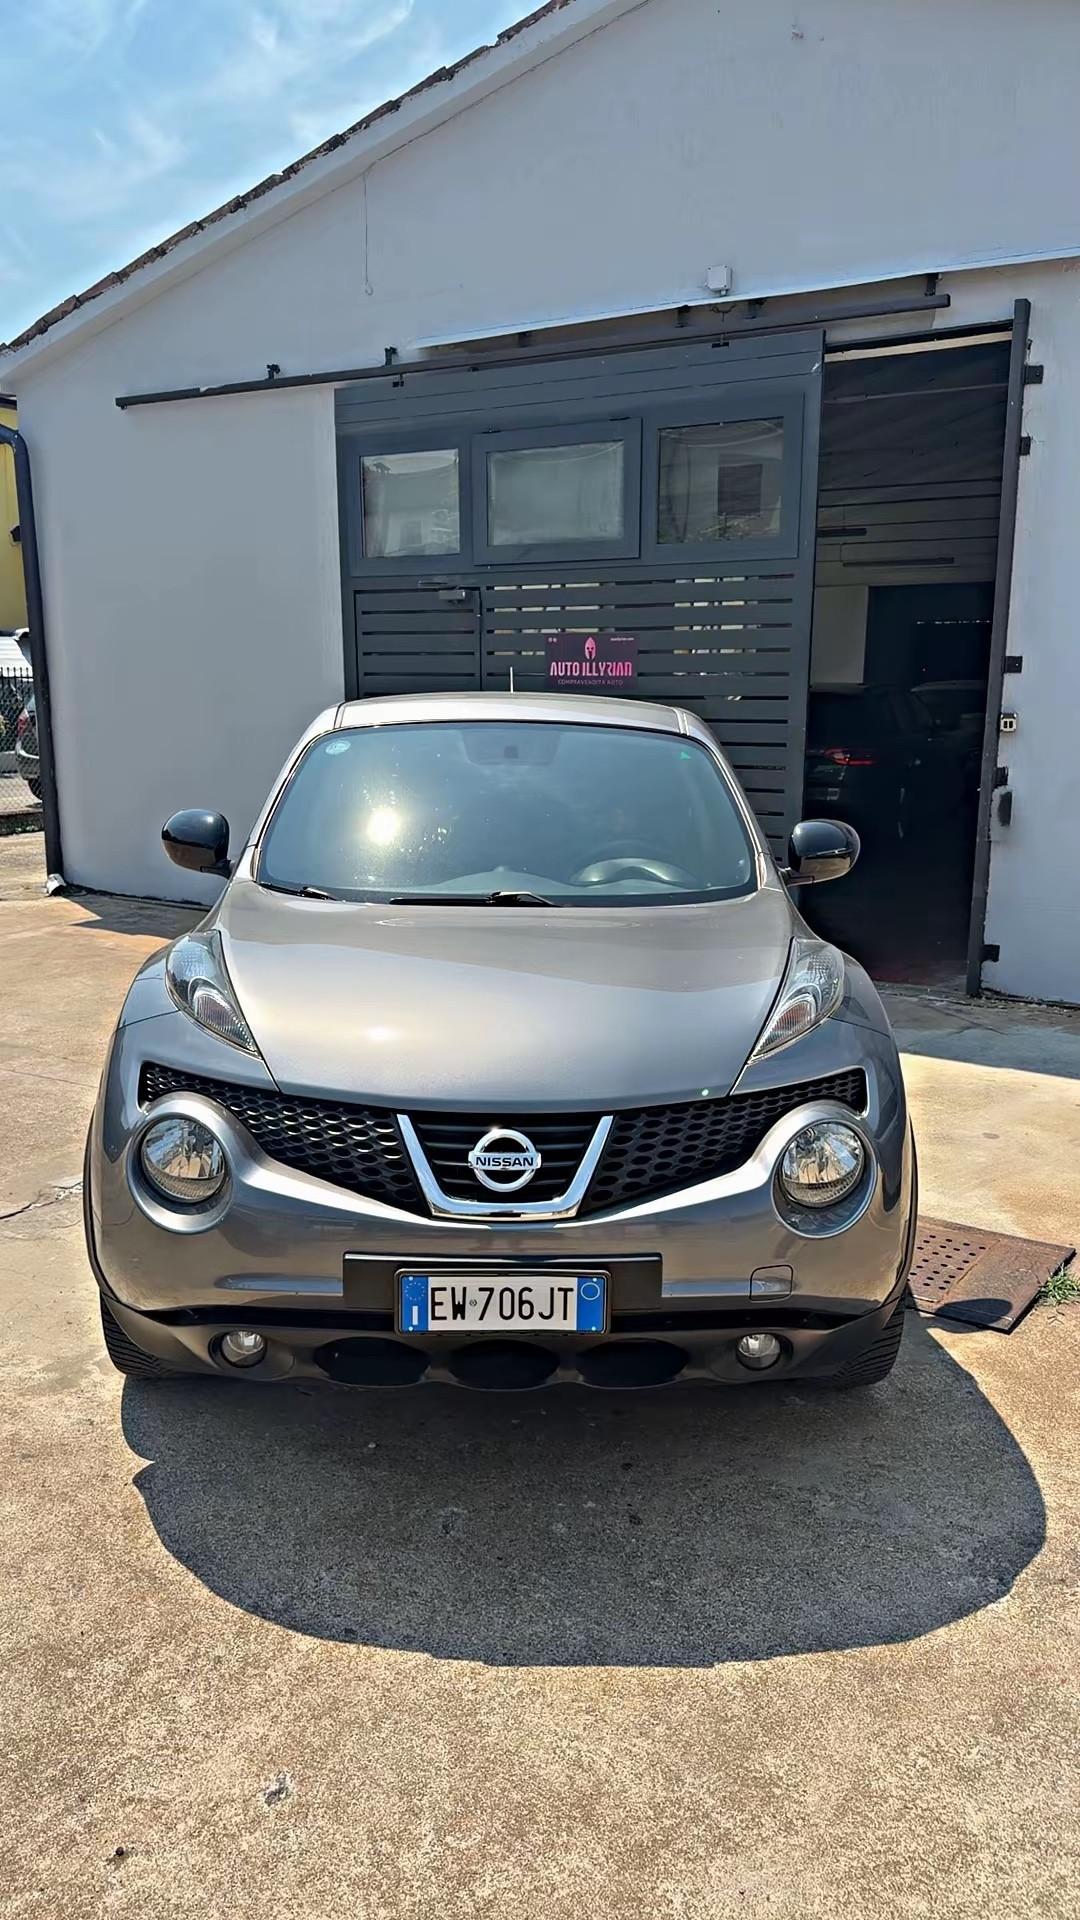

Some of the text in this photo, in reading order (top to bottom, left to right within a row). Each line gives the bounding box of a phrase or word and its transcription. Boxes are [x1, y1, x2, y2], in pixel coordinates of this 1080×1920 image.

[549, 661, 632, 676] AUTO ILLYRIAN
[475, 1156, 534, 1167] NISSAN
